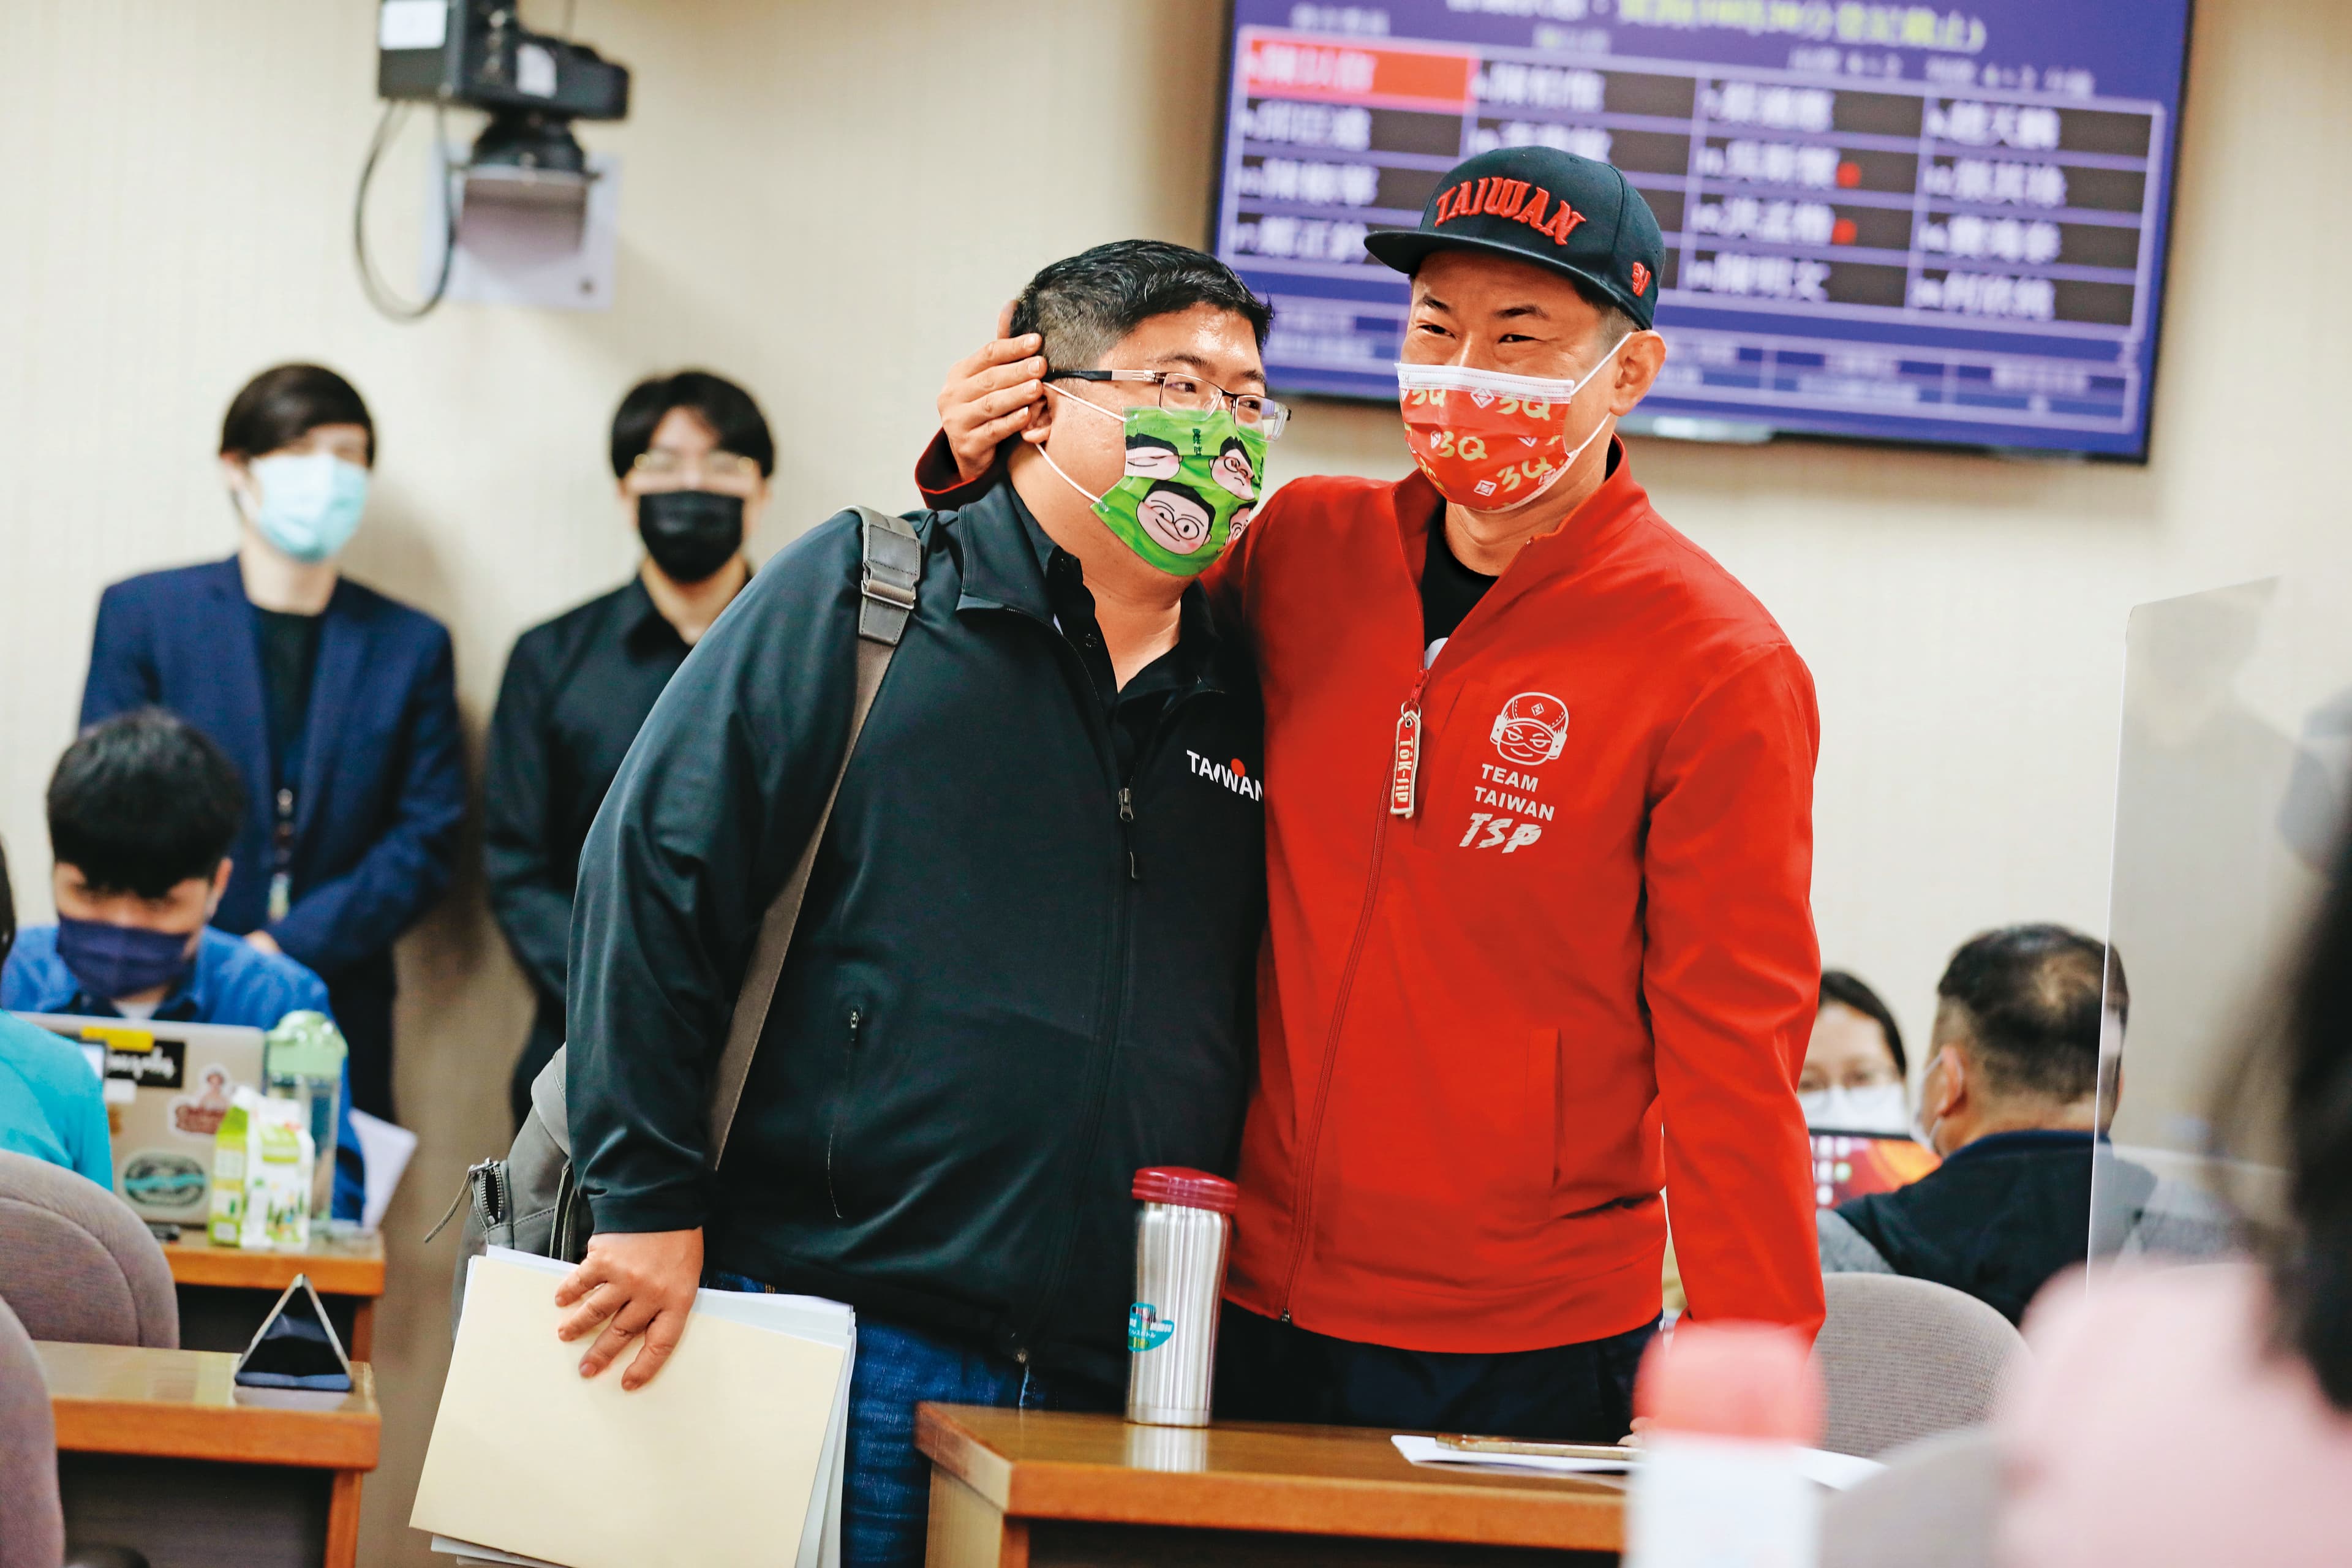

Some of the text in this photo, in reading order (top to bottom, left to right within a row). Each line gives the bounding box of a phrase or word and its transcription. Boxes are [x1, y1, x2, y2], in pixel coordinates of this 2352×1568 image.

[1434, 176, 1586, 245] TAIWAN
[1438, 431, 1488, 461] 3Q
[1186, 749, 1262, 801] TAIWAN
[1481, 763, 1539, 793] TEAM
[1474, 786, 1555, 821] TAIWAN
[1459, 812, 1543, 853] TSP
